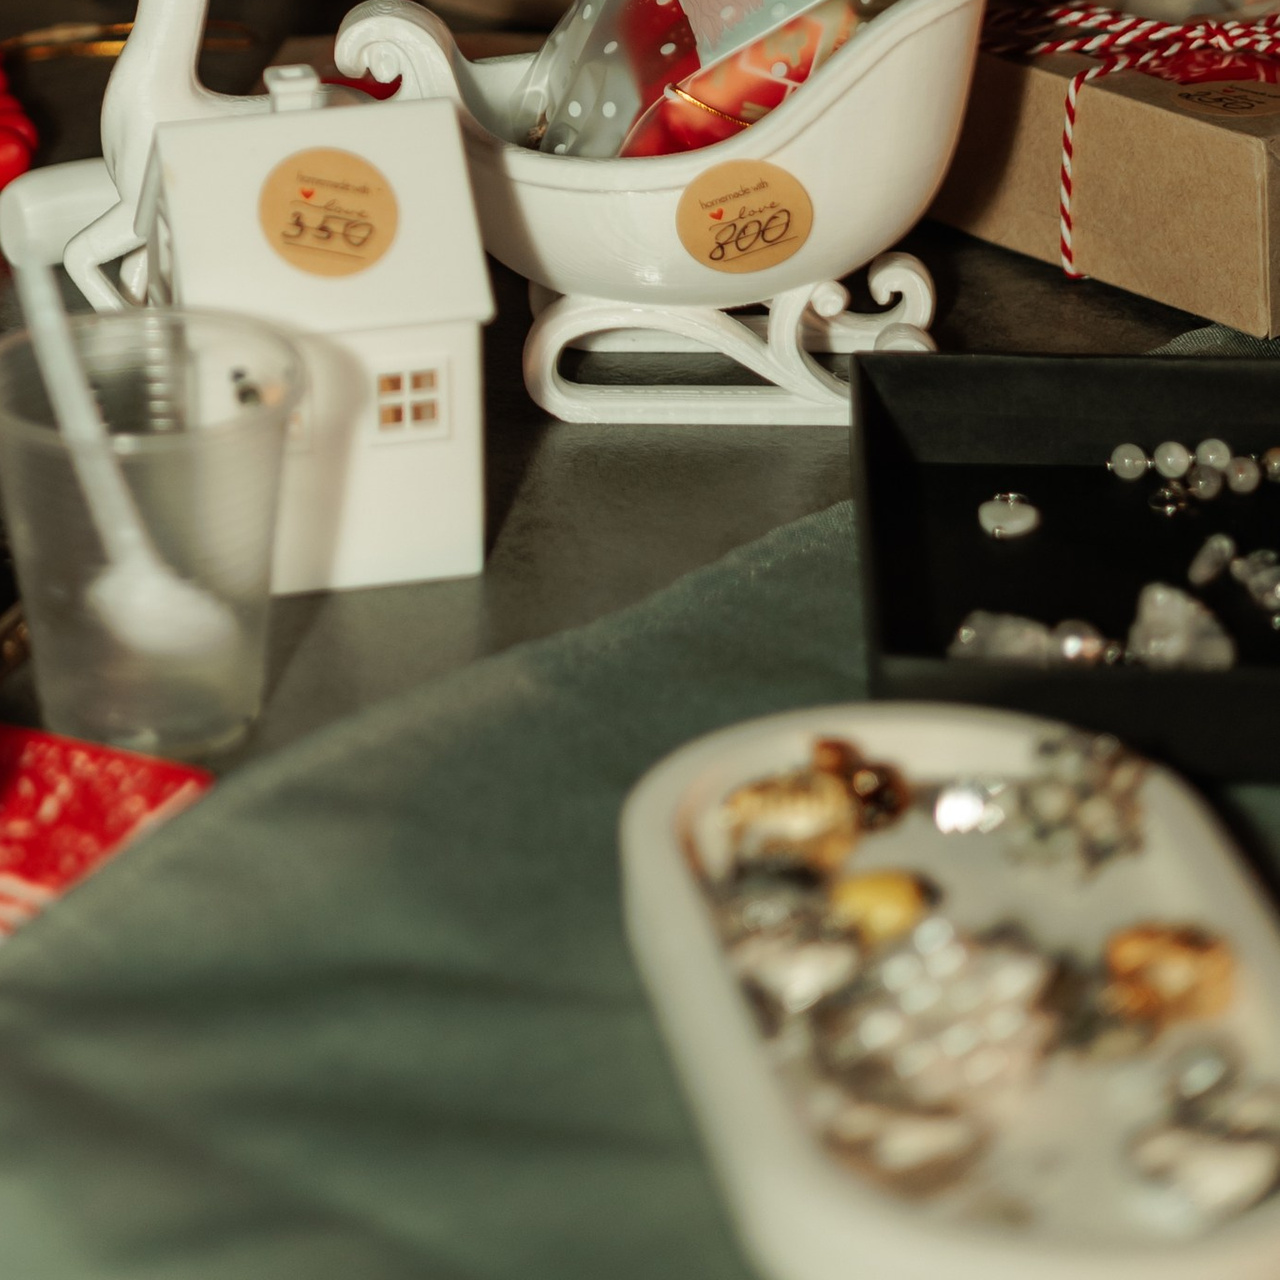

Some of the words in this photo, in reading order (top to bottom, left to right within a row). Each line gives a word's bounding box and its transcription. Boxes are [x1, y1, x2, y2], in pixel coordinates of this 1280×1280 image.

[698, 185, 751, 210] homemade
[752, 177, 769, 192] with
[281, 211, 375, 247] 350
[709, 209, 791, 261] 800
